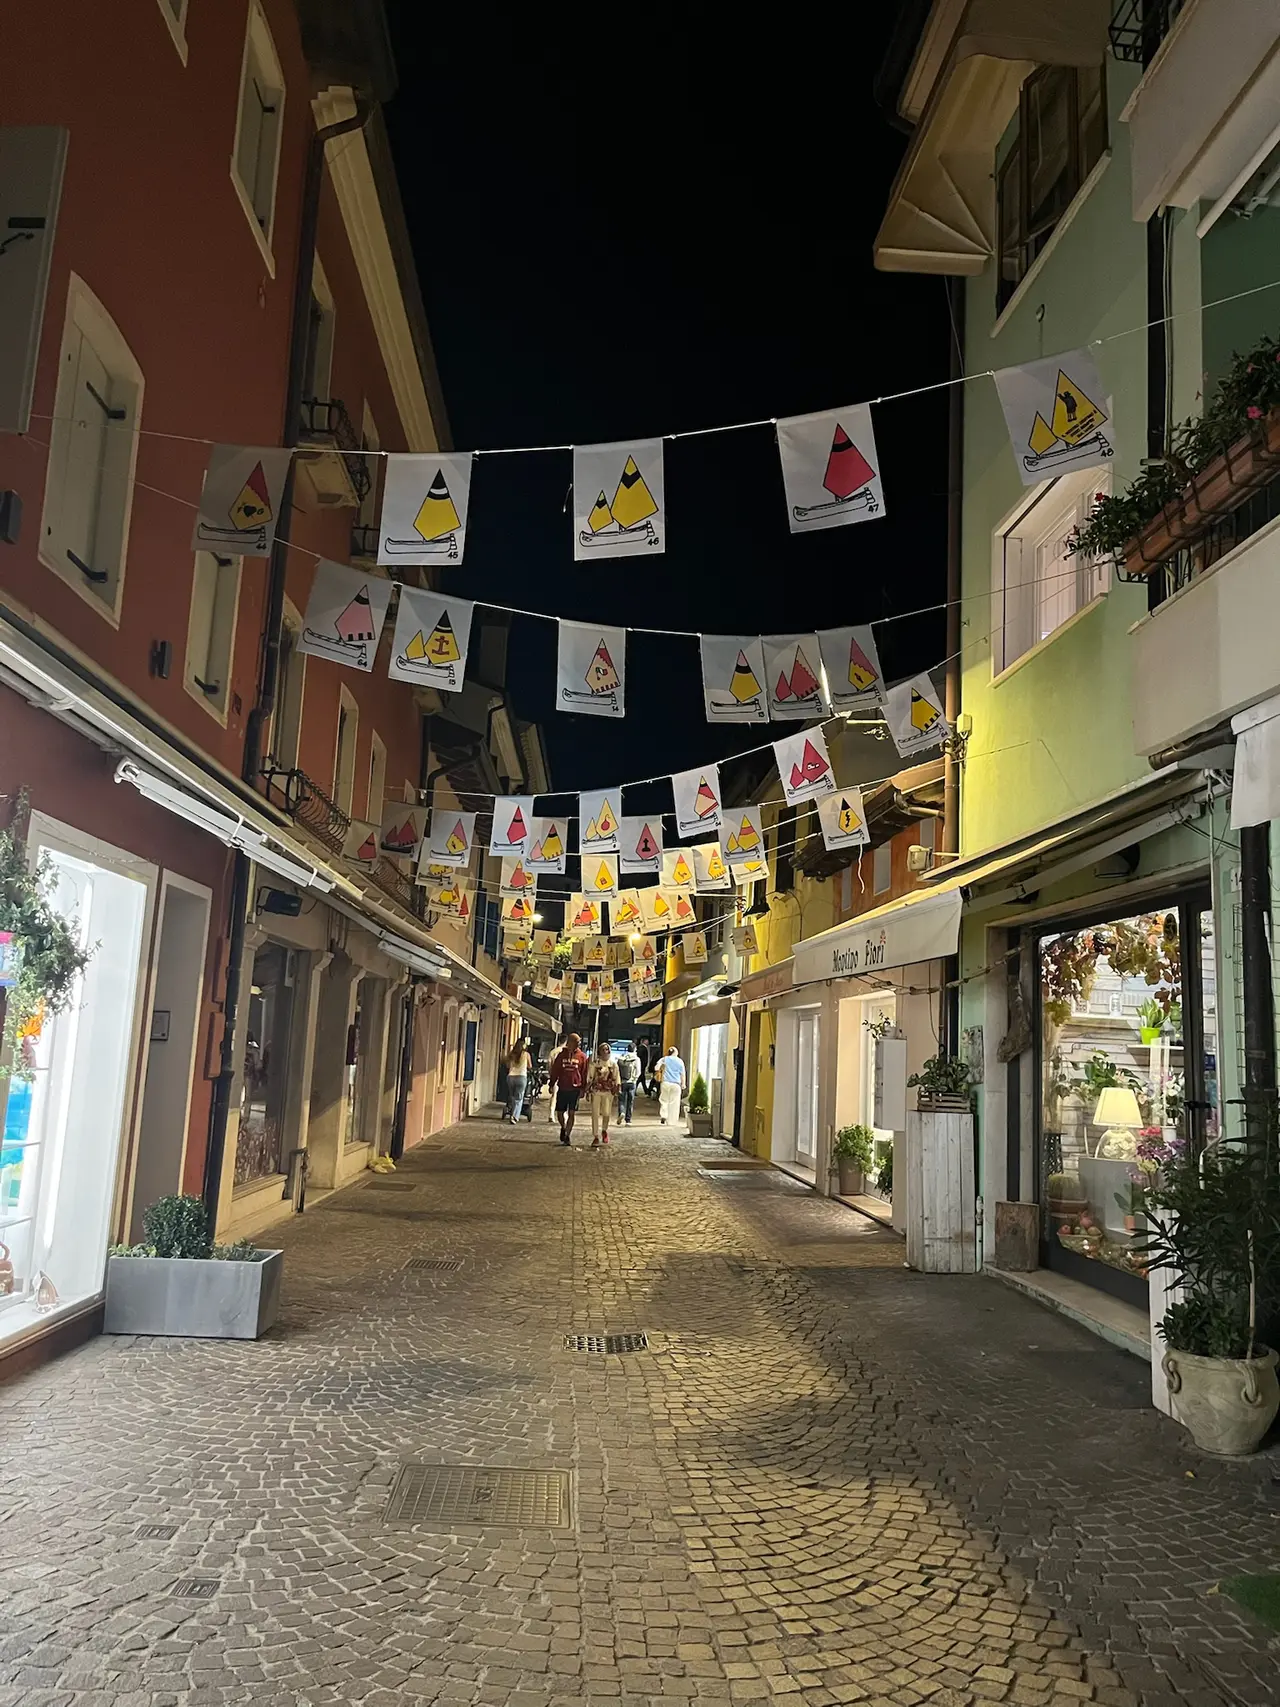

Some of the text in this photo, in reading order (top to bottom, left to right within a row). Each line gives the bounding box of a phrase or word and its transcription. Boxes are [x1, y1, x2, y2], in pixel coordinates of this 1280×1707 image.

[867, 503, 879, 513] 47
[255, 542, 267, 550] 44
[647, 536, 660, 546] 46
[447, 551, 459, 559] 45
[864, 939, 885, 966] Fiori
